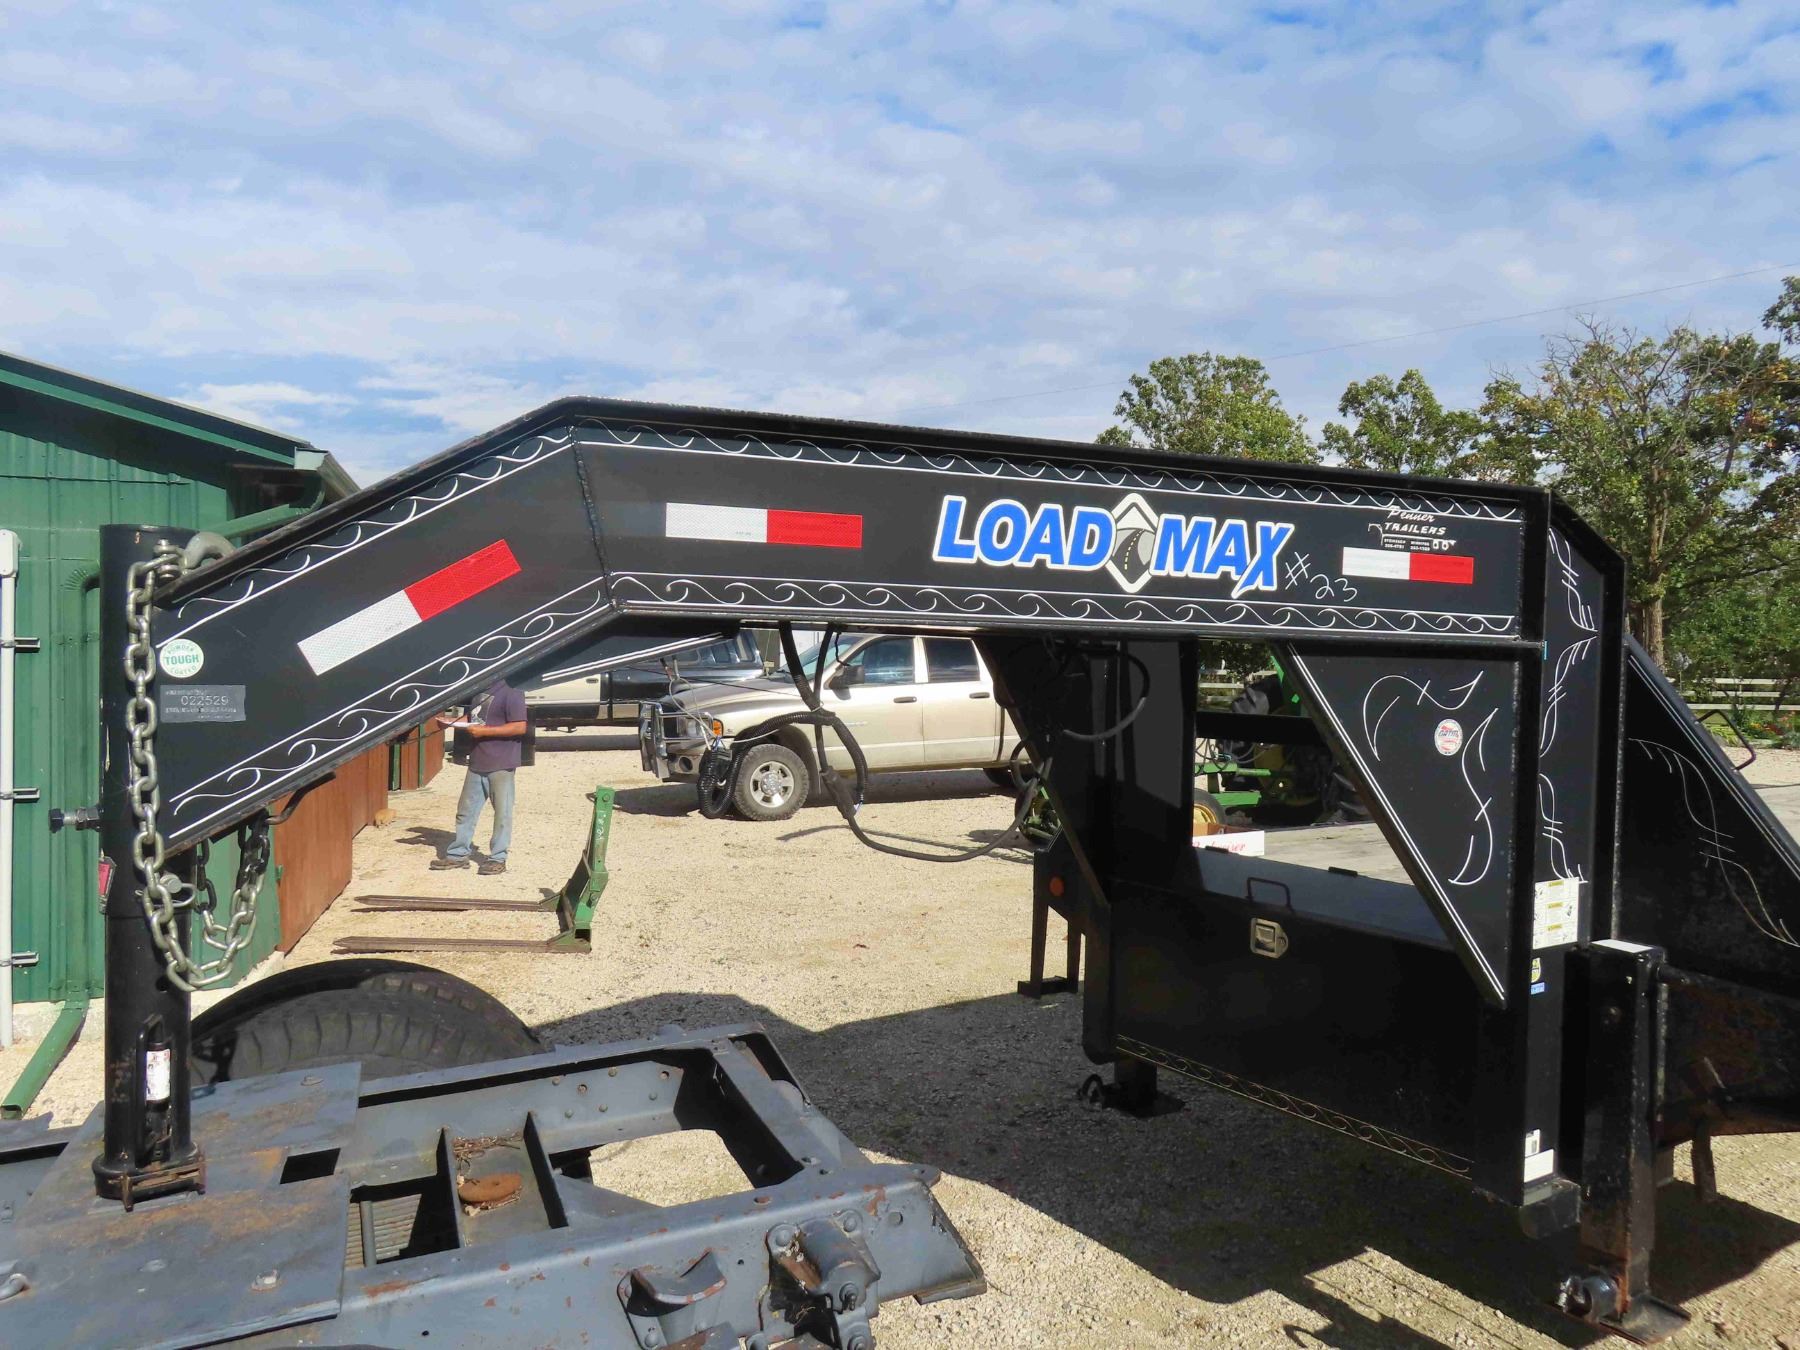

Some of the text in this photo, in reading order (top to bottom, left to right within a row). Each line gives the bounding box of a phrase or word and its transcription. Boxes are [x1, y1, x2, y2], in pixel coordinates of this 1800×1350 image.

[1384, 522, 1446, 535] TRAILERS
[932, 495, 1296, 599] LOAD MAX
[164, 654, 200, 666] TOUGH
[180, 695, 229, 706] 022529
